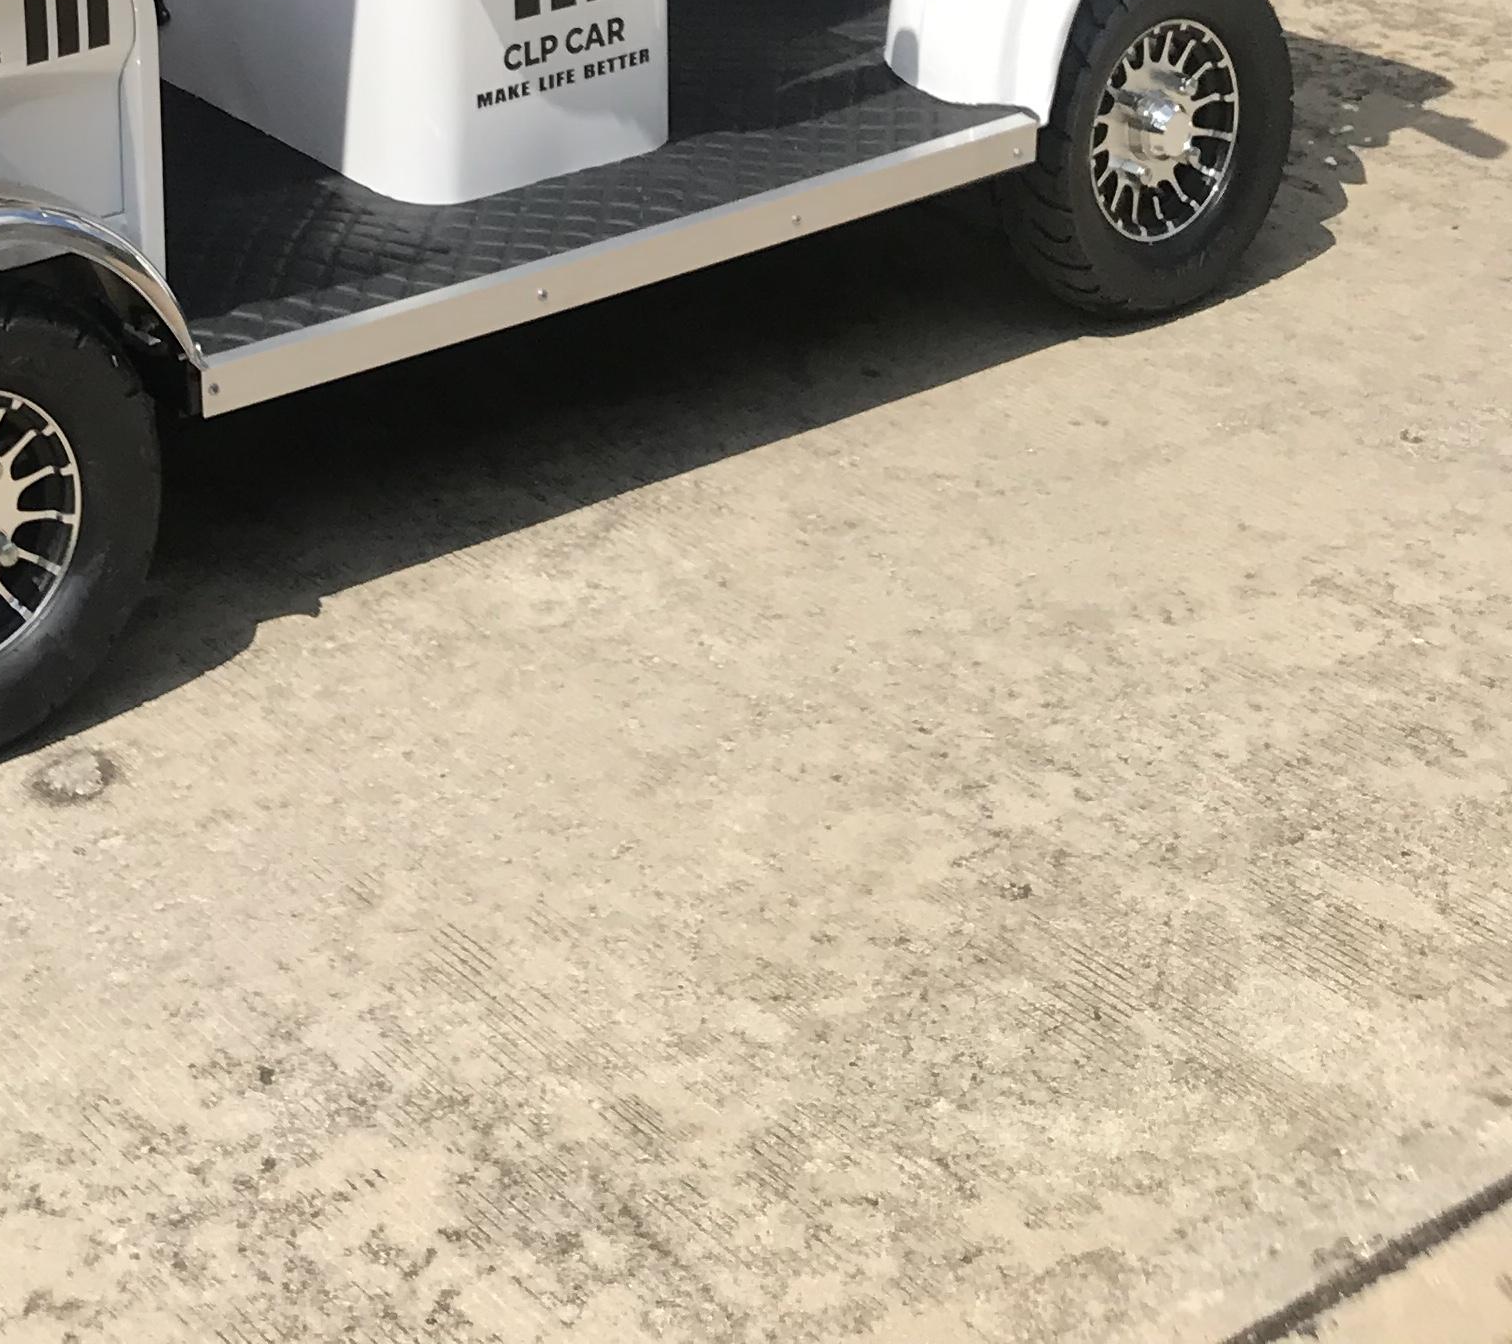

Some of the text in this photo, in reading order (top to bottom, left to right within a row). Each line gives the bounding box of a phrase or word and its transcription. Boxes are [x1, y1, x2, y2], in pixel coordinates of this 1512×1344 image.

[503, 17, 625, 71] CLP CAR
[476, 48, 650, 109] MAKE LIFE BETTER
